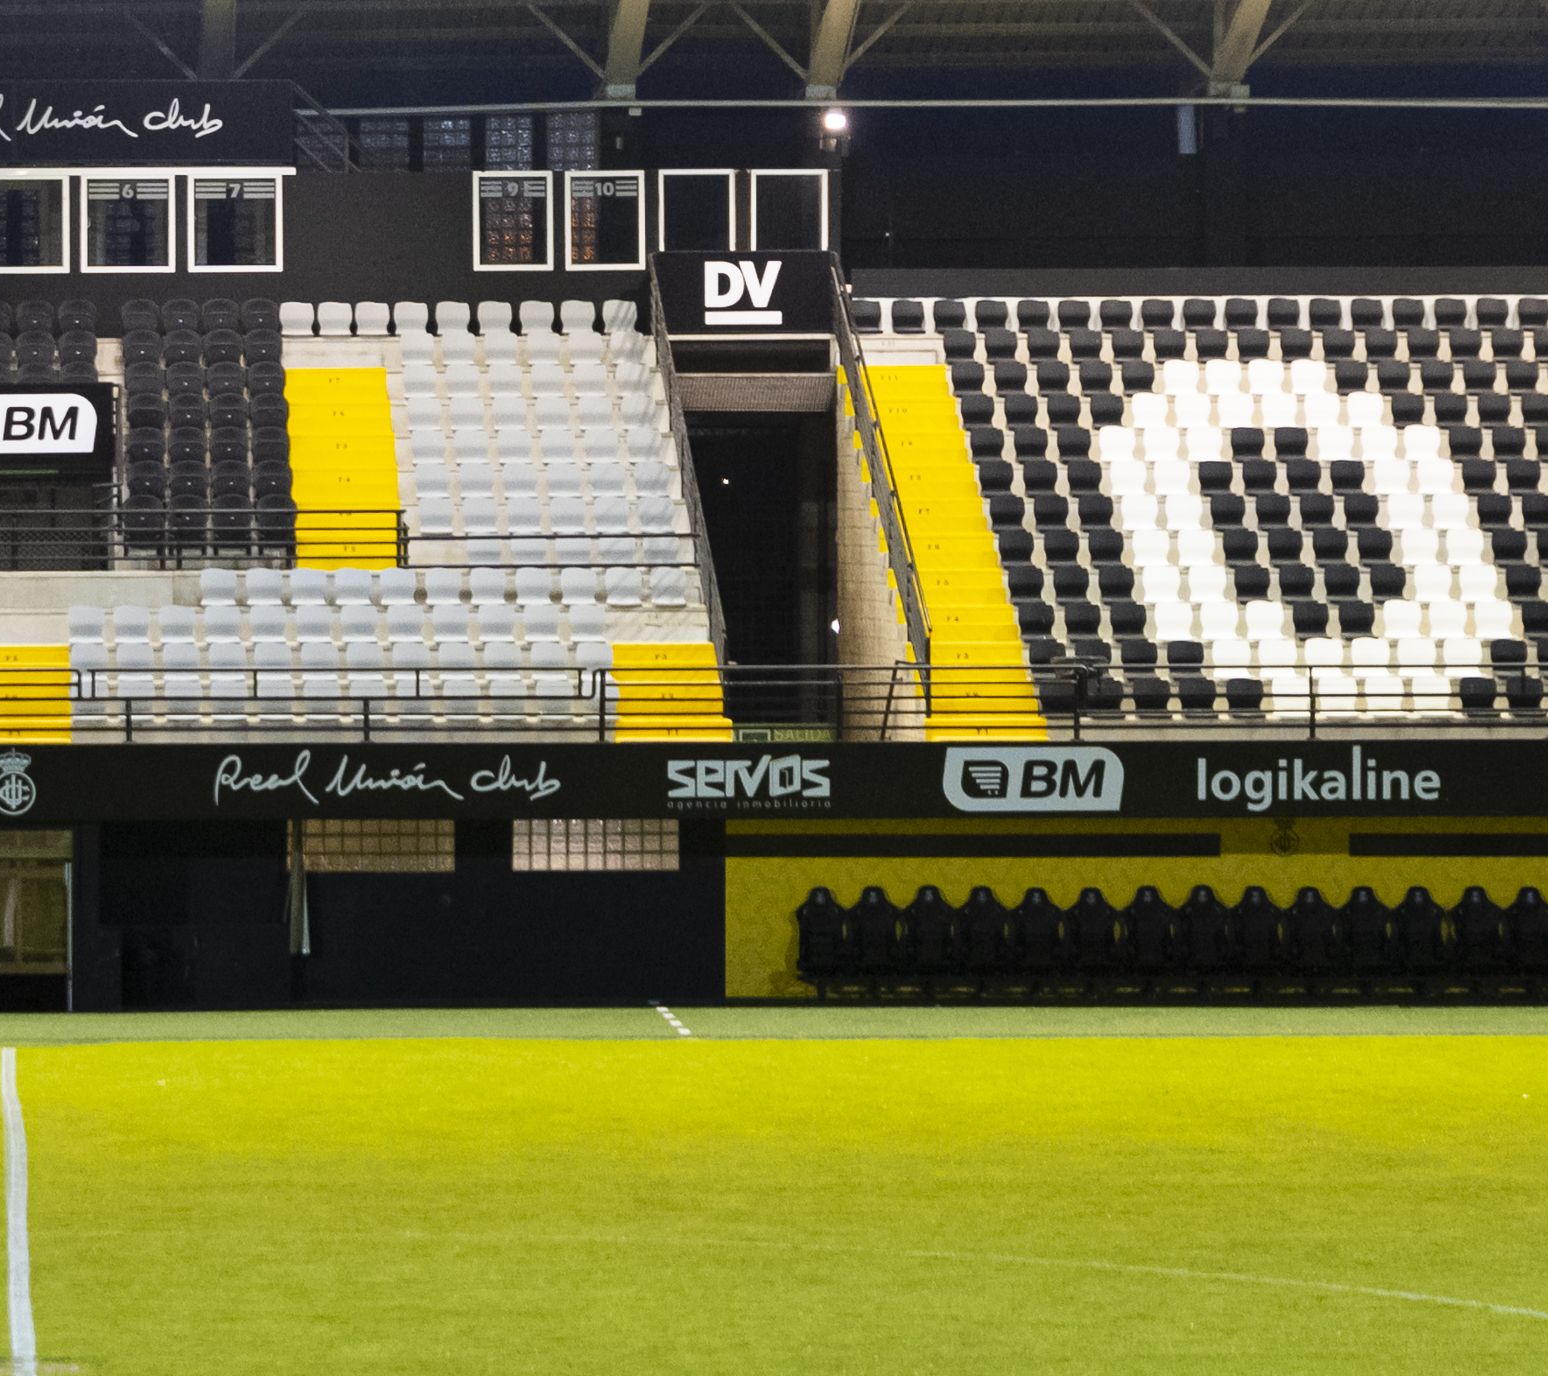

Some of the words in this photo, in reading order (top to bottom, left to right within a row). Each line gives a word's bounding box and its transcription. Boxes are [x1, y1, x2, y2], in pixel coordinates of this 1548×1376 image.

[122, 184, 134, 198] 6
[228, 184, 240, 198] 7
[507, 181, 518, 196] 9
[595, 182, 614, 196] 10
[704, 261, 782, 308] DV
[3, 406, 78, 441] BM
[1106, 359, 1525, 718] 0
[215, 750, 319, 805] Real
[1020, 759, 1105, 798] BM
[1197, 745, 1441, 812] logikaline
[667, 801, 726, 810] agencia
[737, 799, 830, 808] inmobiliaria
